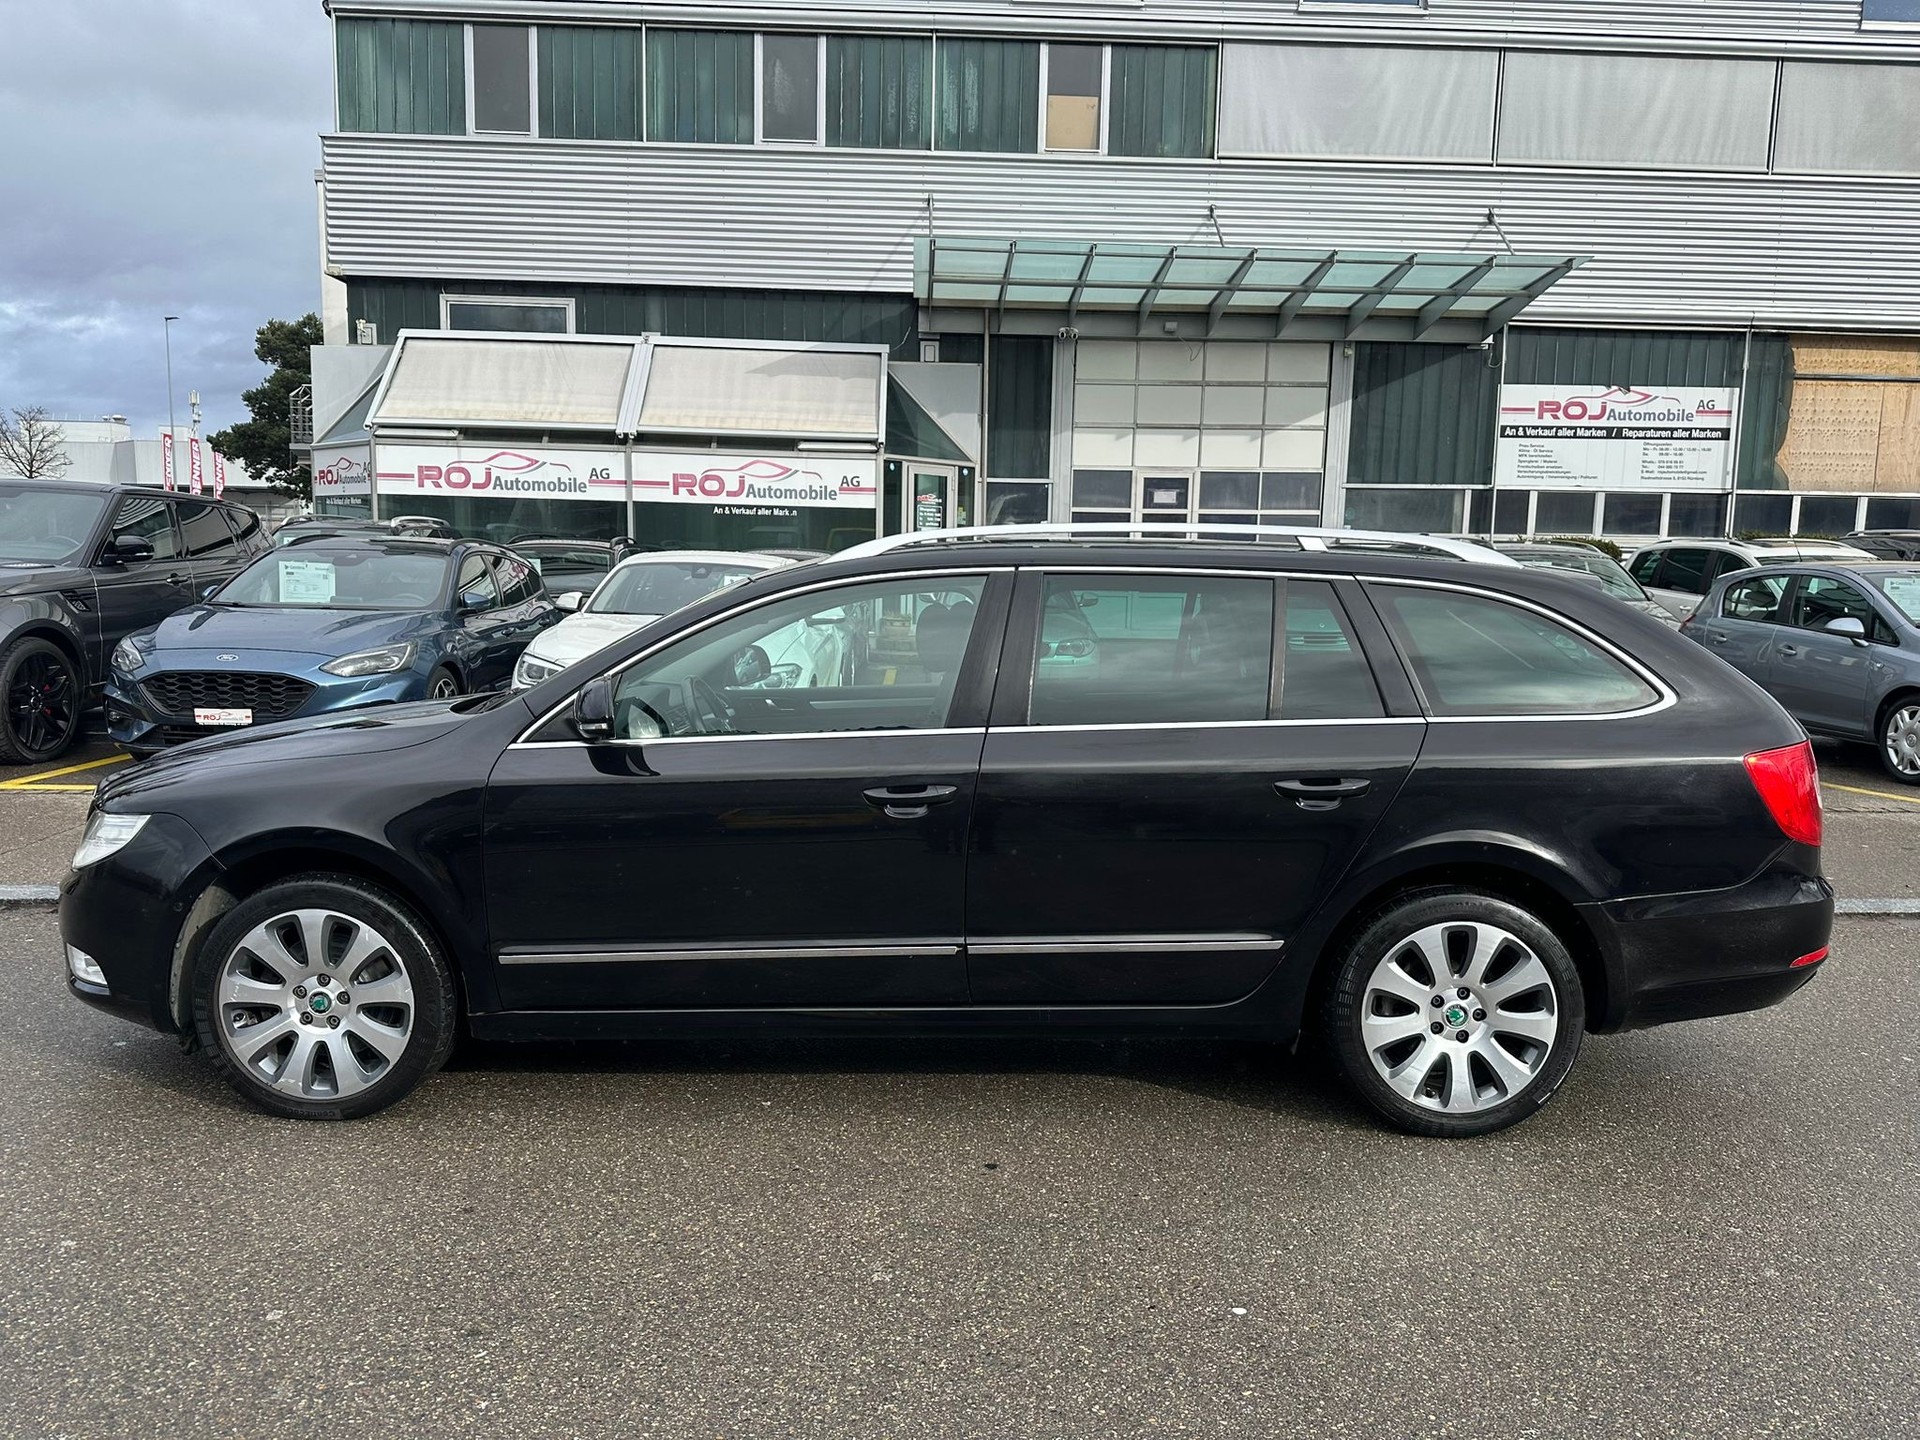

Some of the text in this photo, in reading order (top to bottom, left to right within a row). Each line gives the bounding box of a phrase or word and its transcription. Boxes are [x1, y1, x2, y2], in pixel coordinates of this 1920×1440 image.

[1537, 400, 1694, 422] ROJ Automobile
[1696, 399, 1716, 410] AG
[1504, 427, 1517, 436] An
[1518, 427, 1524, 436] &
[1525, 427, 1556, 437] Verkauf
[1557, 427, 1575, 437] aller
[1576, 428, 1607, 437] Marken
[1622, 428, 1673, 440] Reparaturen
[1674, 429, 1691, 438] aller
[1691, 429, 1722, 438] Marken
[318, 468, 339, 486] ROJ
[417, 465, 588, 493] ROJ Automobile
[589, 467, 610, 480] AG
[672, 472, 838, 501] ROJ Automobile
[840, 475, 861, 488] AG
[713, 506, 724, 514] An
[730, 506, 756, 516] Verkauf
[757, 507, 772, 516] aller
